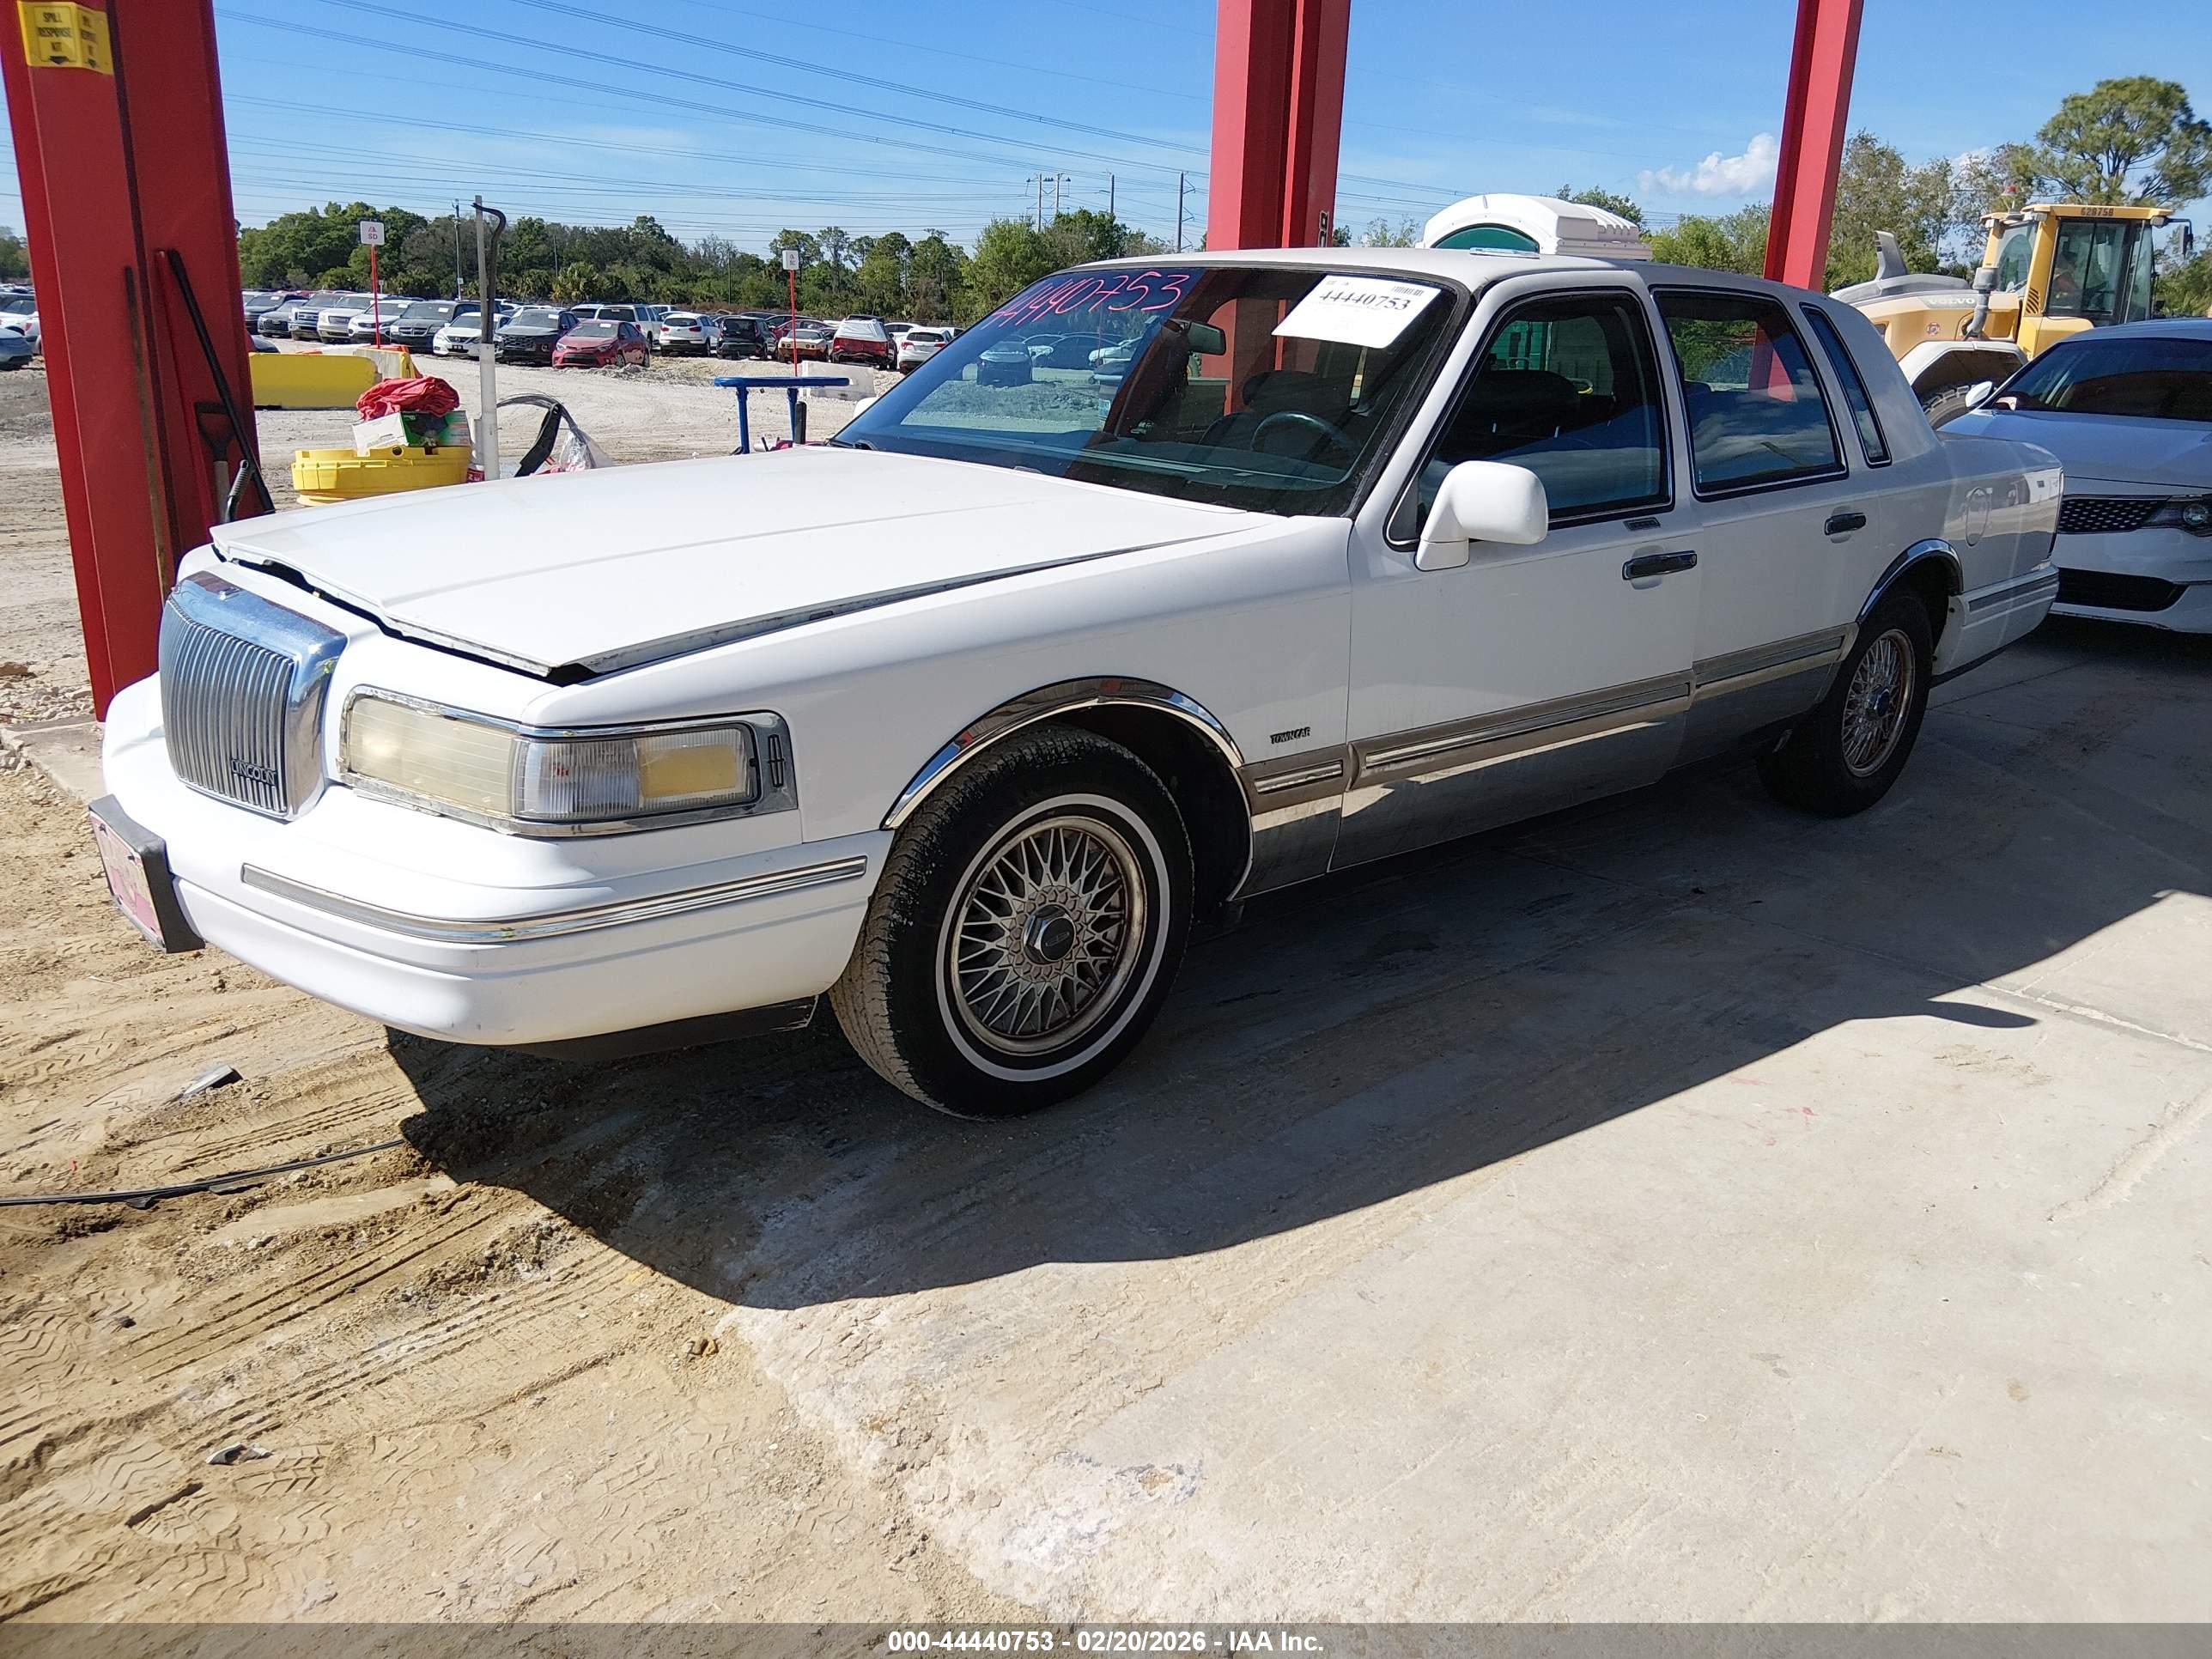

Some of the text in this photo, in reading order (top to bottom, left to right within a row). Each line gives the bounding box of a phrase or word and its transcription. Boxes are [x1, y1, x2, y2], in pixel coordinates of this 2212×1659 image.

[43, 12, 62, 23] SPILL
[37, 27, 72, 38] RESPONSE
[980, 270, 1190, 331] 44440753
[1319, 290, 1411, 311] 44440753
[231, 759, 276, 786] LINCOLN
